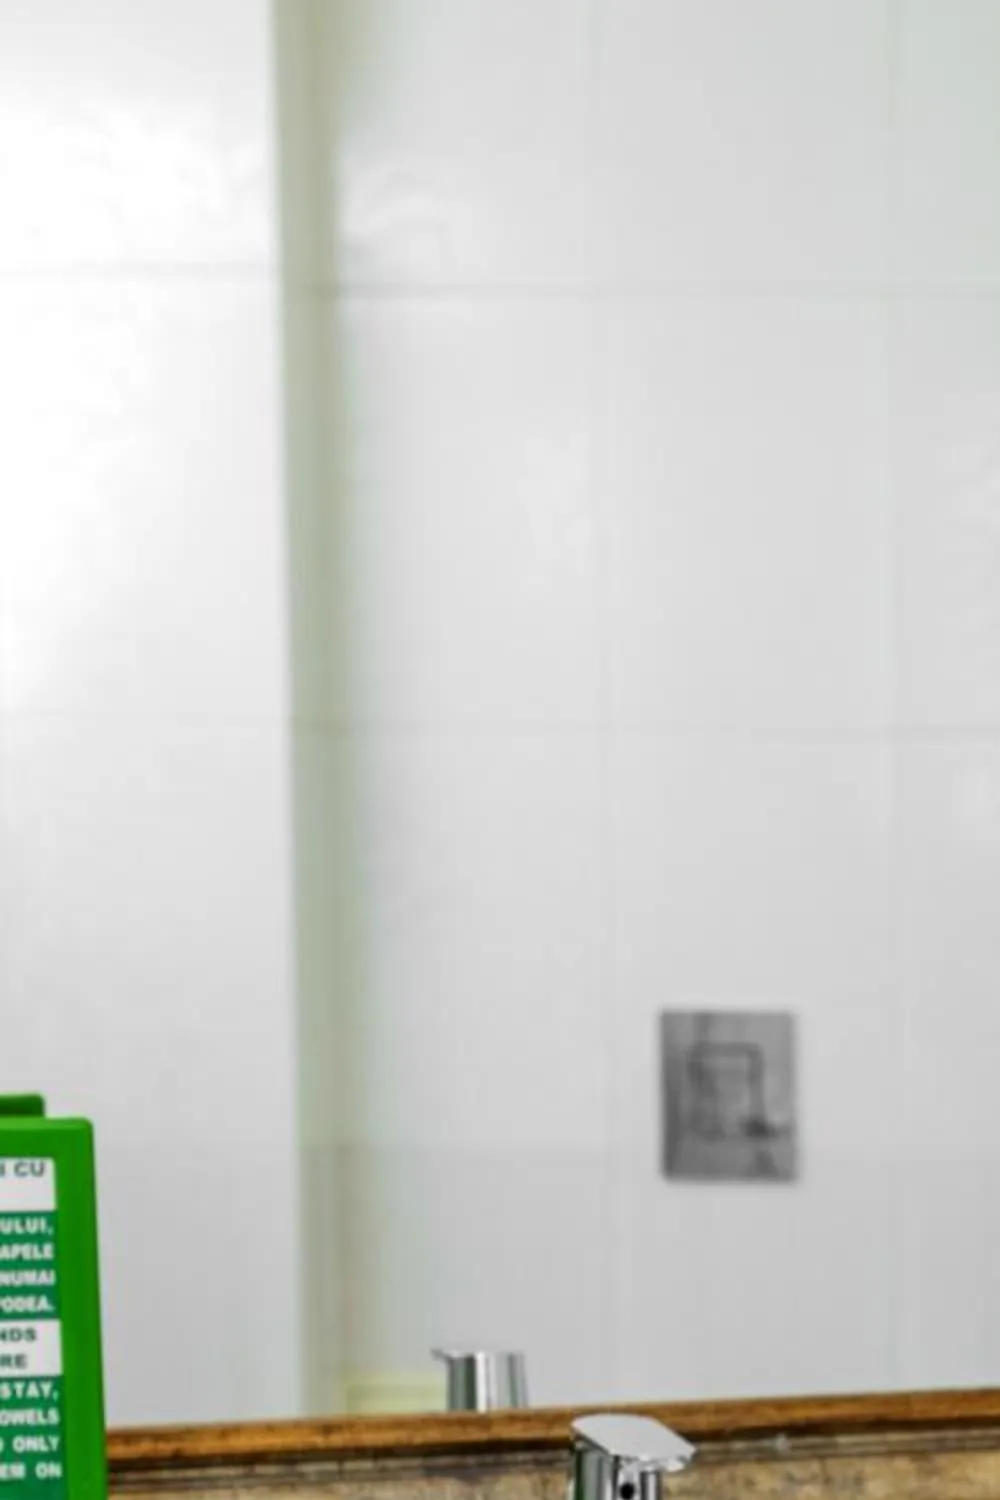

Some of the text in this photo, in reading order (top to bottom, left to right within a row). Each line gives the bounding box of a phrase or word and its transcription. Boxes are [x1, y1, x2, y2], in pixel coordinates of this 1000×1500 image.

[14, 1161, 46, 1178] CU
[12, 1434, 60, 1453] ONLY
[35, 1461, 62, 1479] ON
